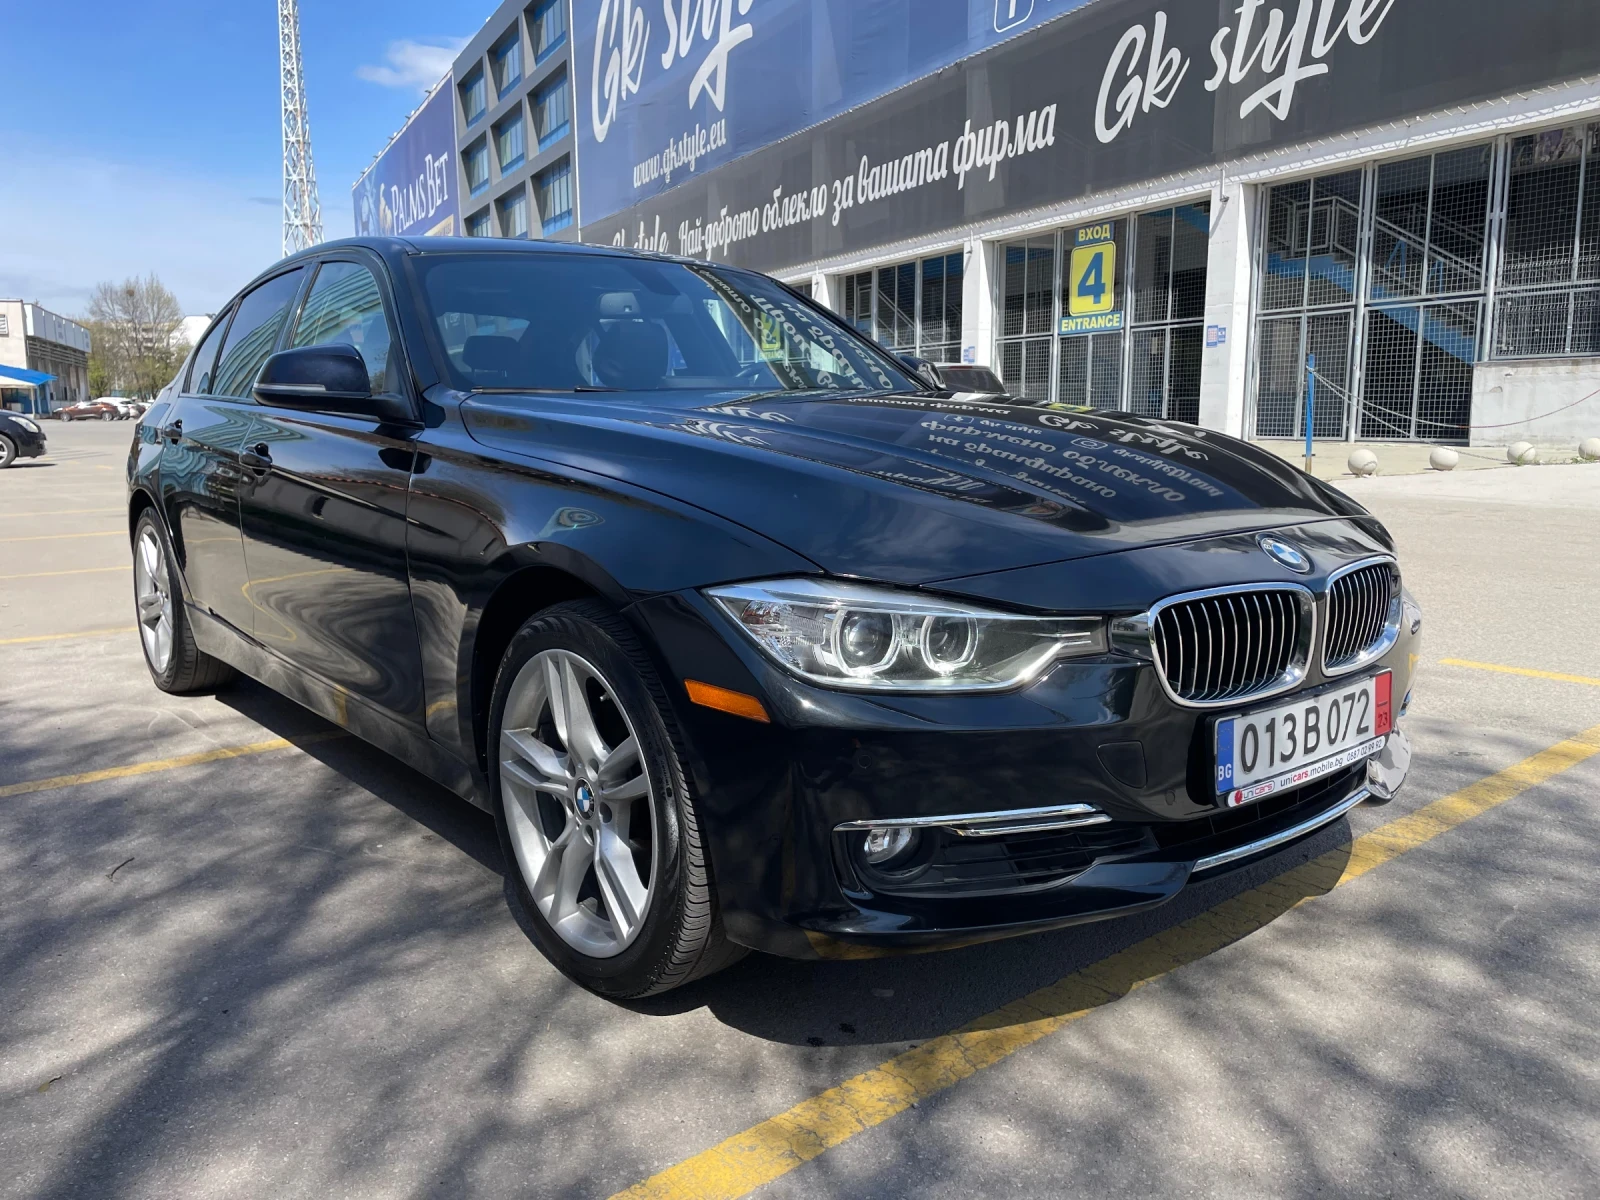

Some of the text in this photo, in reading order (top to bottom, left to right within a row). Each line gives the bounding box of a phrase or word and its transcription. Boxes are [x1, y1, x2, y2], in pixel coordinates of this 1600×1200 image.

[592, 0, 650, 143] Gk
[1095, 11, 1190, 144] Gk
[633, 118, 727, 188] www.gkstyle.eu
[678, 103, 1056, 262] Най-доброто облекло за вашата фирма
[390, 151, 449, 237] PALMS BET
[1077, 223, 1112, 243] ВХОД
[1077, 251, 1107, 305] 4
[1060, 312, 1121, 333] ENTRANCE
[1240, 687, 1370, 775] 013B072
[1377, 711, 1388, 728] 23
[1218, 763, 1232, 781] BG
[1280, 757, 1344, 788] unicars.mobile.bg
